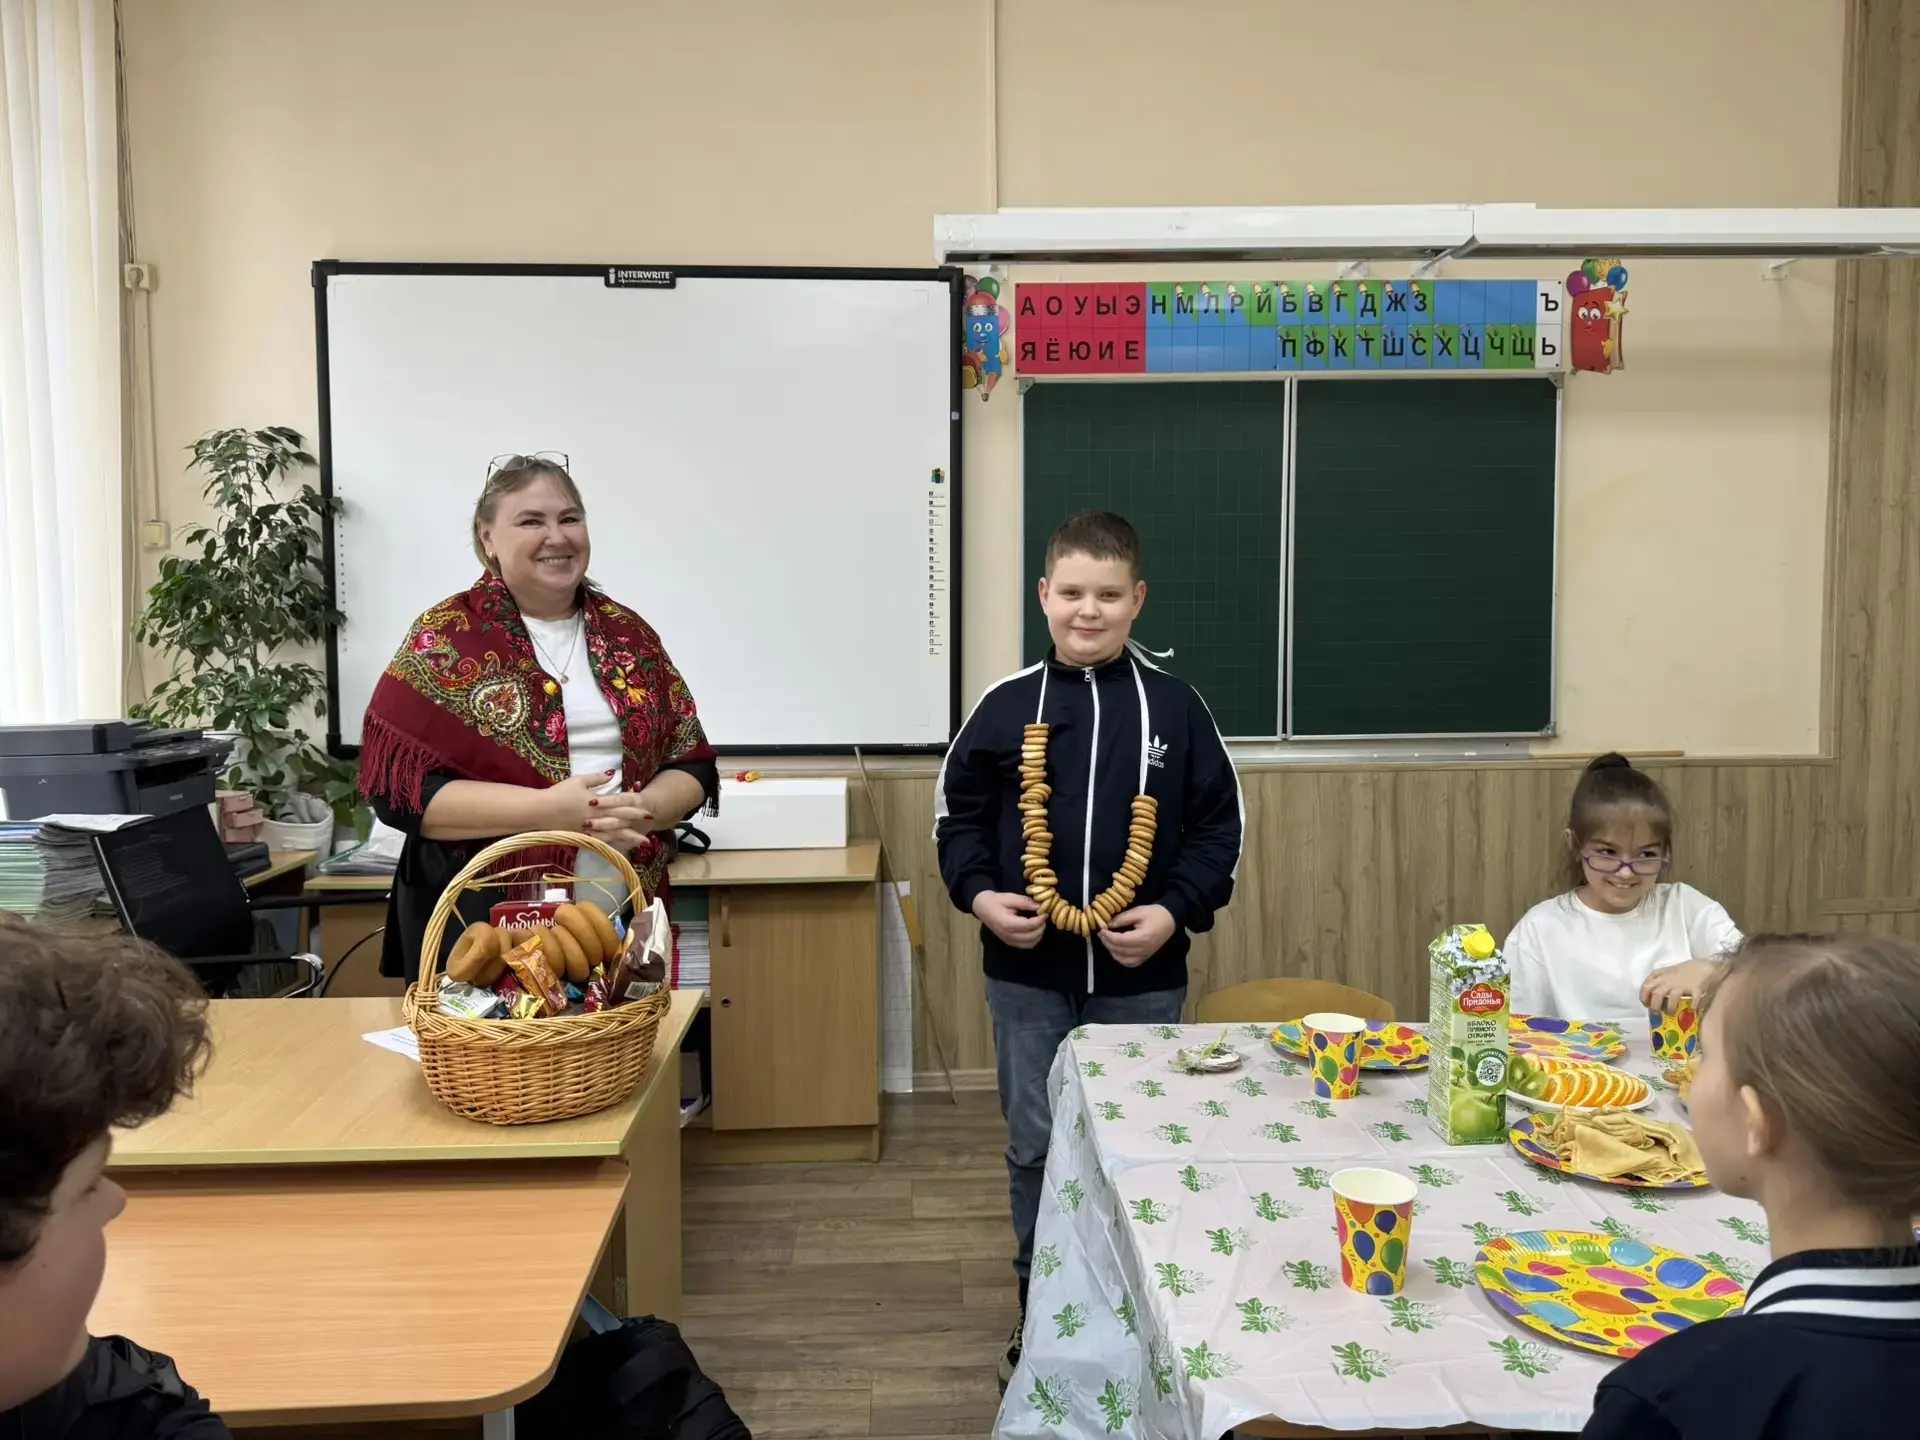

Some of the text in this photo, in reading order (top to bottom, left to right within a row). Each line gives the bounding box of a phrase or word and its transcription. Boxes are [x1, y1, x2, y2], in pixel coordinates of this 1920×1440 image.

[617, 270, 671, 279] INTERWRITE
[1020, 289, 1559, 318] А О У Ы Э Н М Л Р Й Б В Г Д Ж З Ъ
[1020, 337, 1557, 361] Я Ё Ю И Е П Ф К Т Ш С Х Ц Ч Щ Ь
[499, 911, 557, 931] Любимы
[1470, 991, 1493, 999] Сады
[1463, 998, 1501, 1008] Придонья
